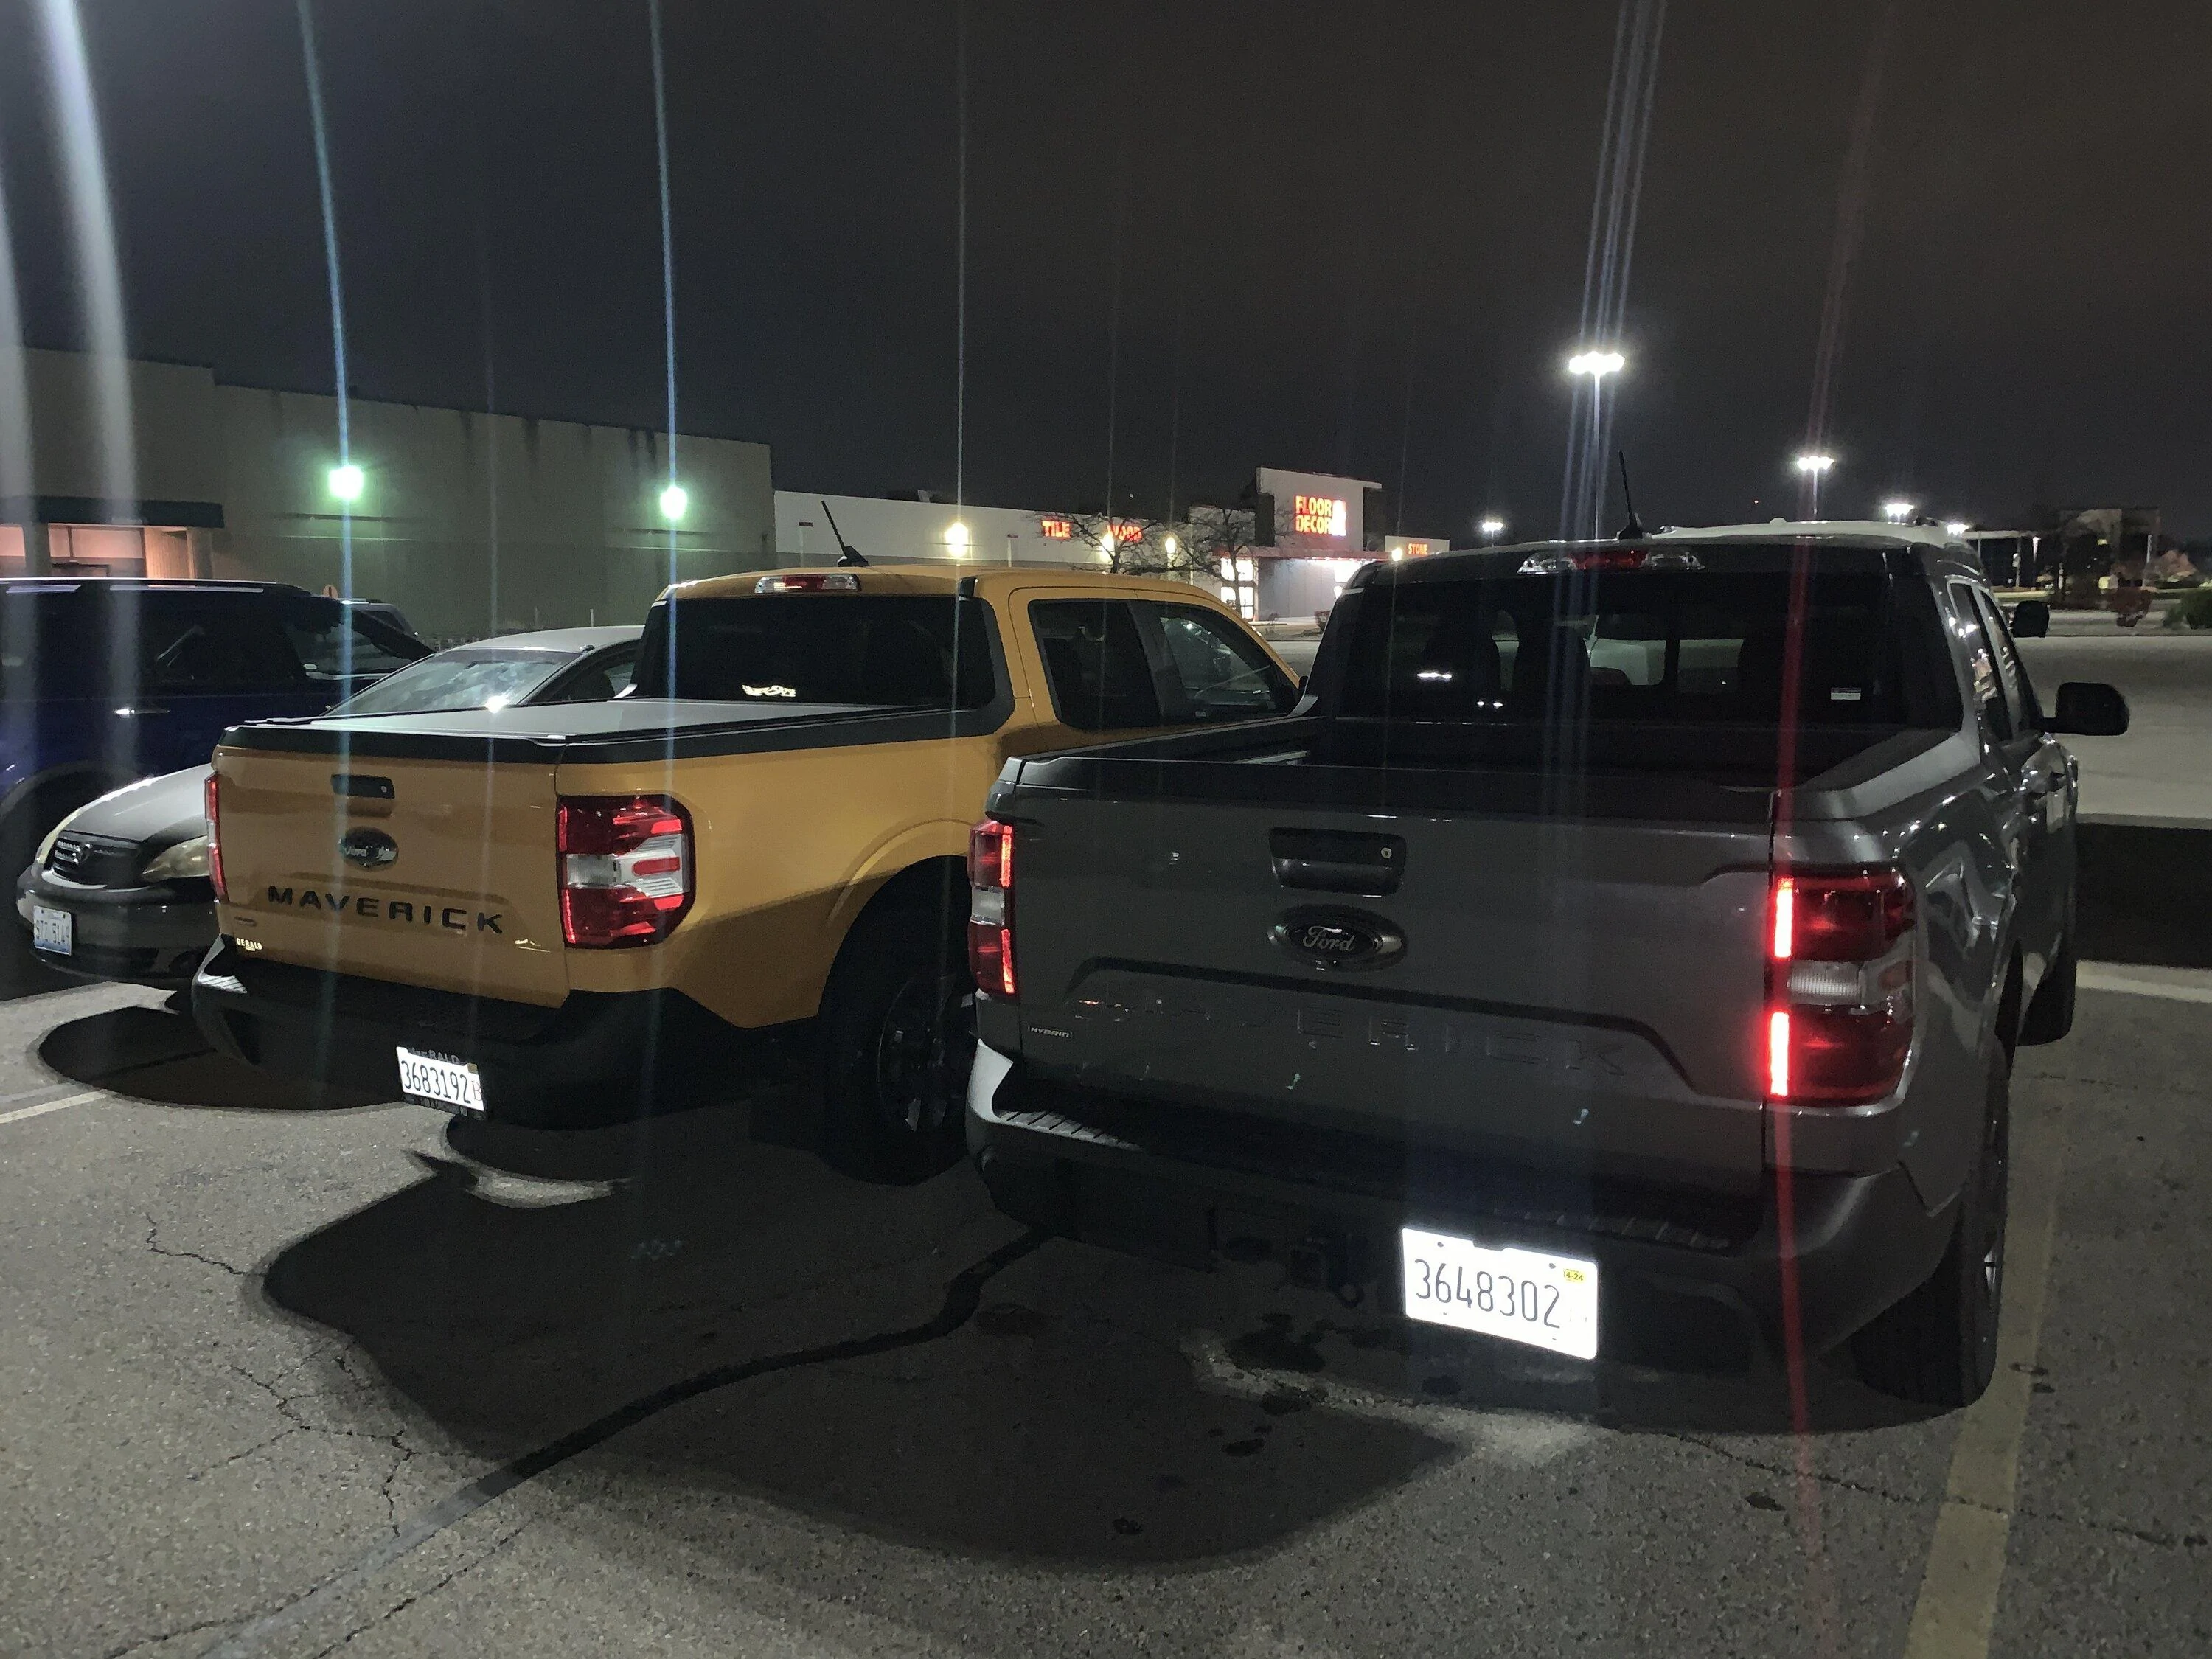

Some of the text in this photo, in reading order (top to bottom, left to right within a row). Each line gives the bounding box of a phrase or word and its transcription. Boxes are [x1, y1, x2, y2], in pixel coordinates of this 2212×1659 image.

[1295, 495, 1332, 517] FLOOR
[1042, 520, 1071, 538] TILE
[1295, 515, 1333, 535] DECOR
[1408, 543, 1428, 555] STONE
[268, 885, 503, 934] MAVERICK
[236, 937, 262, 950] GERALD
[1302, 925, 1356, 952] Ford
[401, 1060, 471, 1104] 3683192
[1413, 1259, 1560, 1329] 3648302
